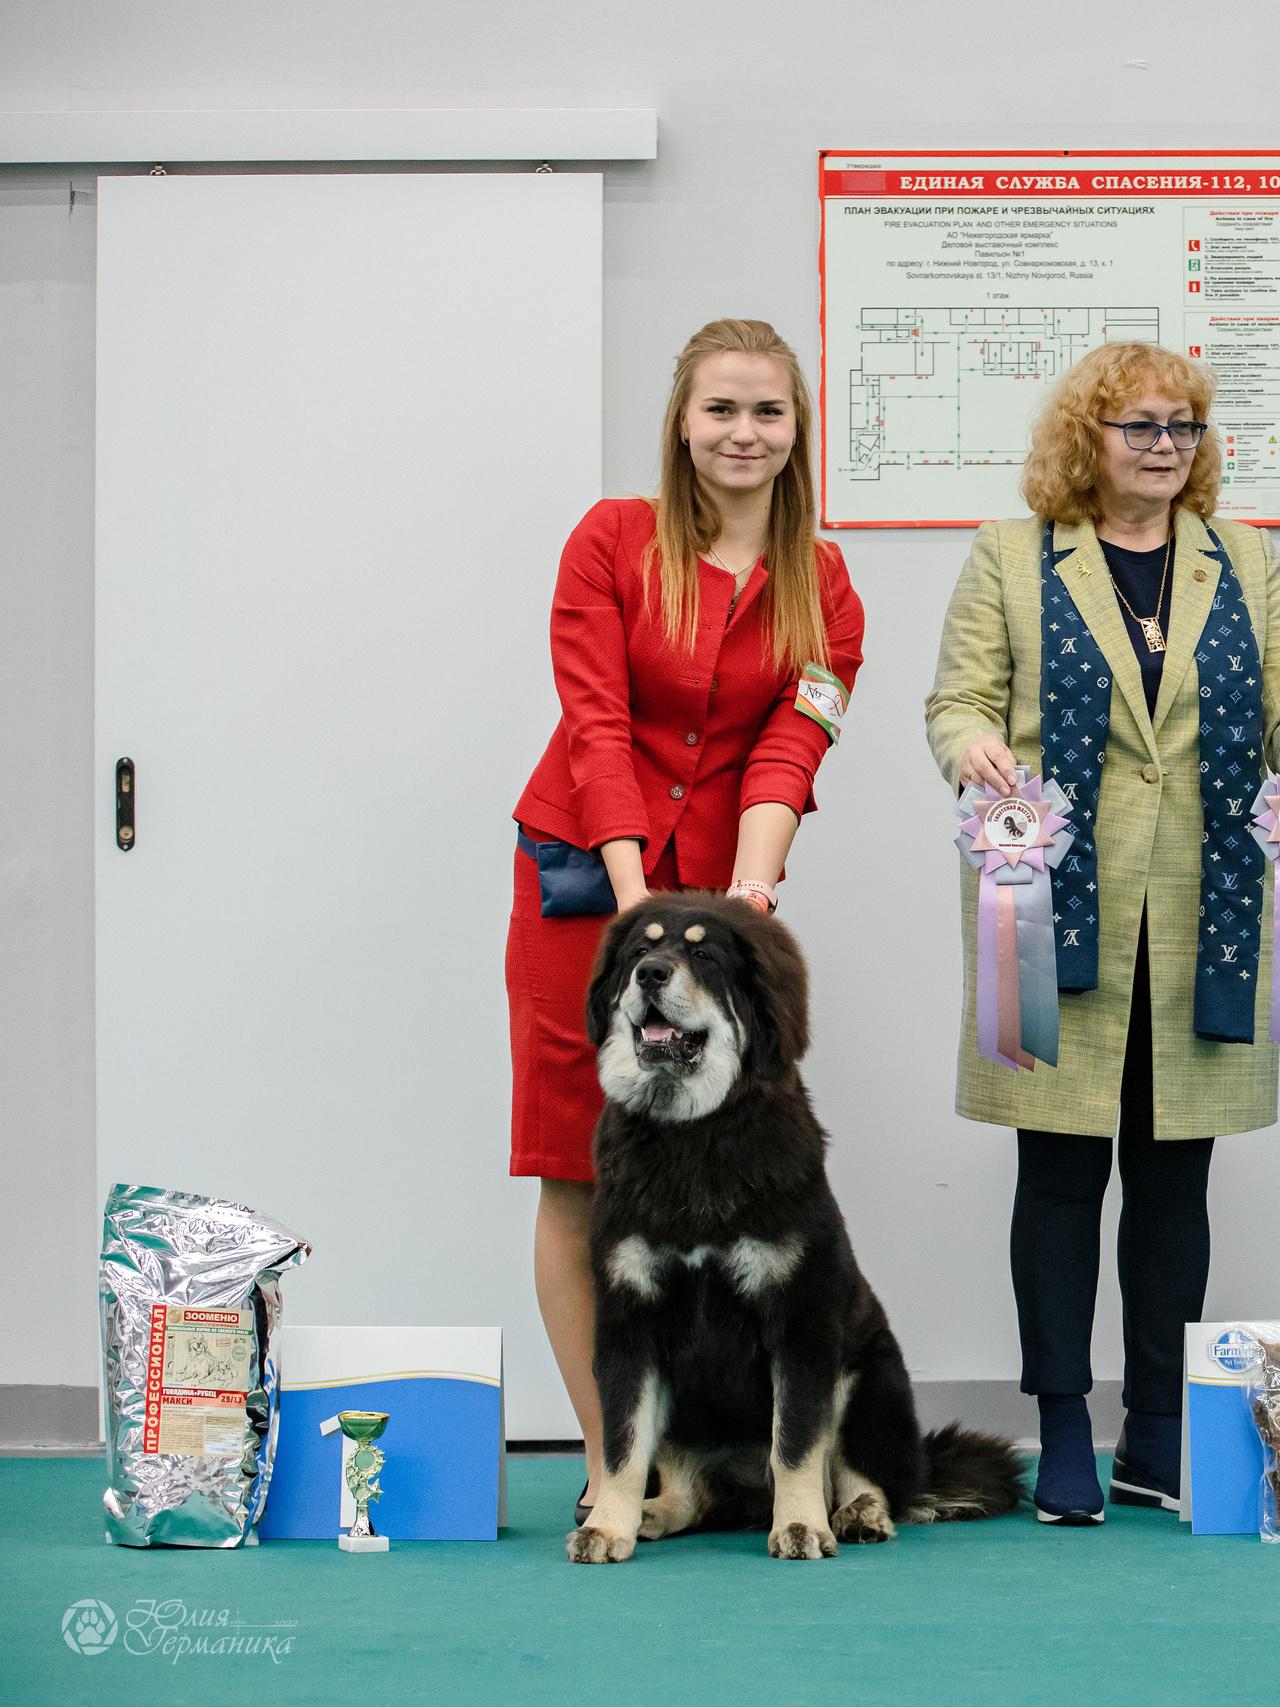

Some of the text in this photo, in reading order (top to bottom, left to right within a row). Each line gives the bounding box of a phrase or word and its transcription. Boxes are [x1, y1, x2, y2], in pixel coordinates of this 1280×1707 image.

[900, 176, 984, 191] ЕДИНАЯ
[995, 176, 1080, 190] СЛУЖБА
[1091, 176, 1252, 191] СПАСЕНИЯ-112,
[844, 205, 1155, 216] ПЛАН ЭВАКУАЦИИ ПРИ ПОЖАРЕ И ЧРЕЗВЫЧАЙНЫХ СИТУАЦИЯХ
[941, 240, 973, 249] Деловой
[975, 250, 1011, 258] Павильон
[906, 272, 974, 280] Sovnarkomovskaya
[1006, 272, 1029, 280] Nizhny
[185, 1312, 238, 1322] ЗООМЕНЮ
[146, 1308, 165, 1451] ПРОФЕССИОНАЛ
[162, 1395, 242, 1405] МАКСИ 25/13
